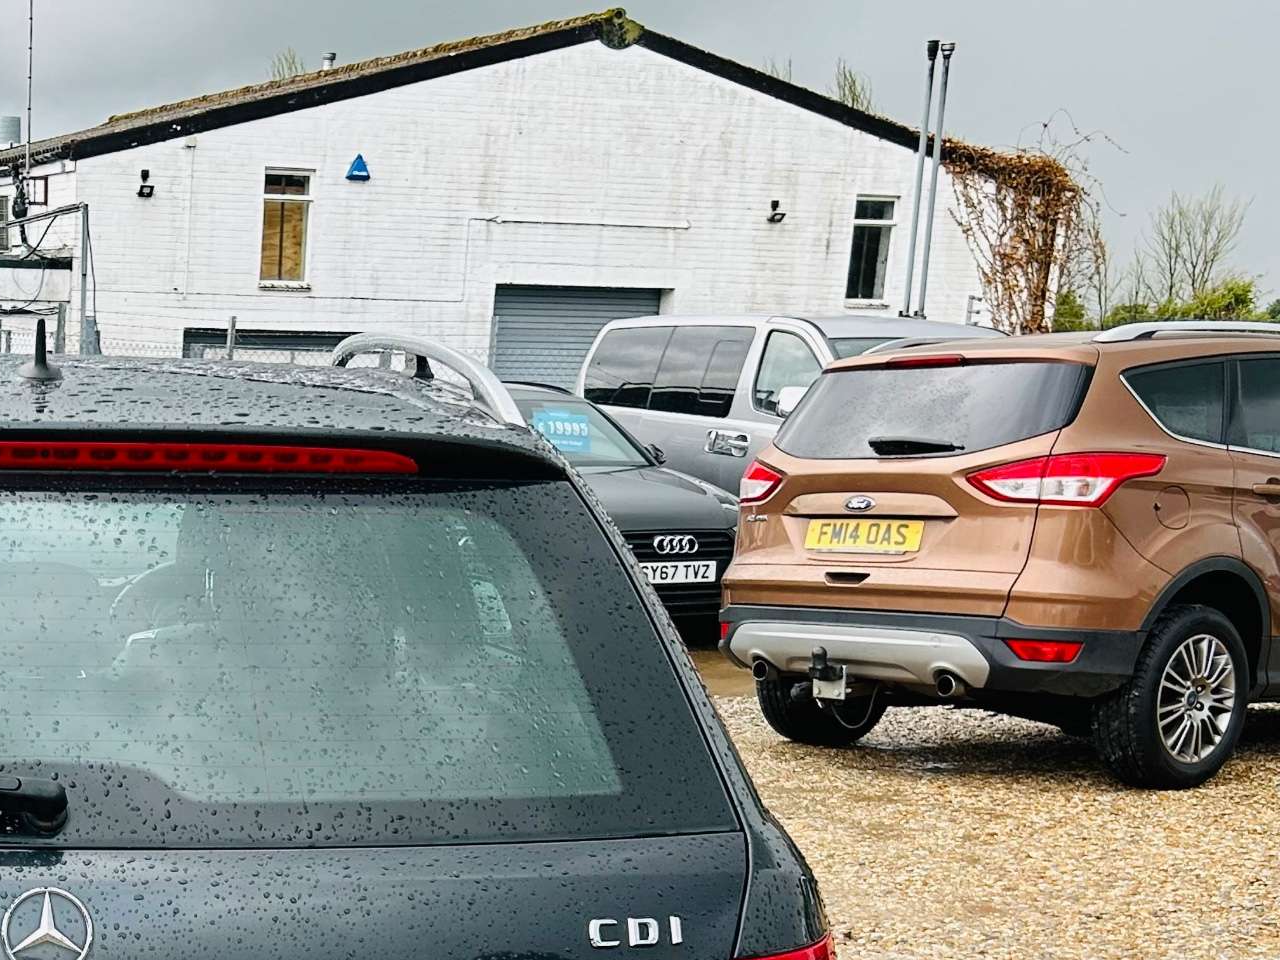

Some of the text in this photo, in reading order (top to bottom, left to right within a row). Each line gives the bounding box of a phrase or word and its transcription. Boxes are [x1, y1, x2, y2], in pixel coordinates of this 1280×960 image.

[817, 522, 861, 545] FM14
[683, 563, 710, 580] TVZ
[588, 915, 683, 948] CDI
